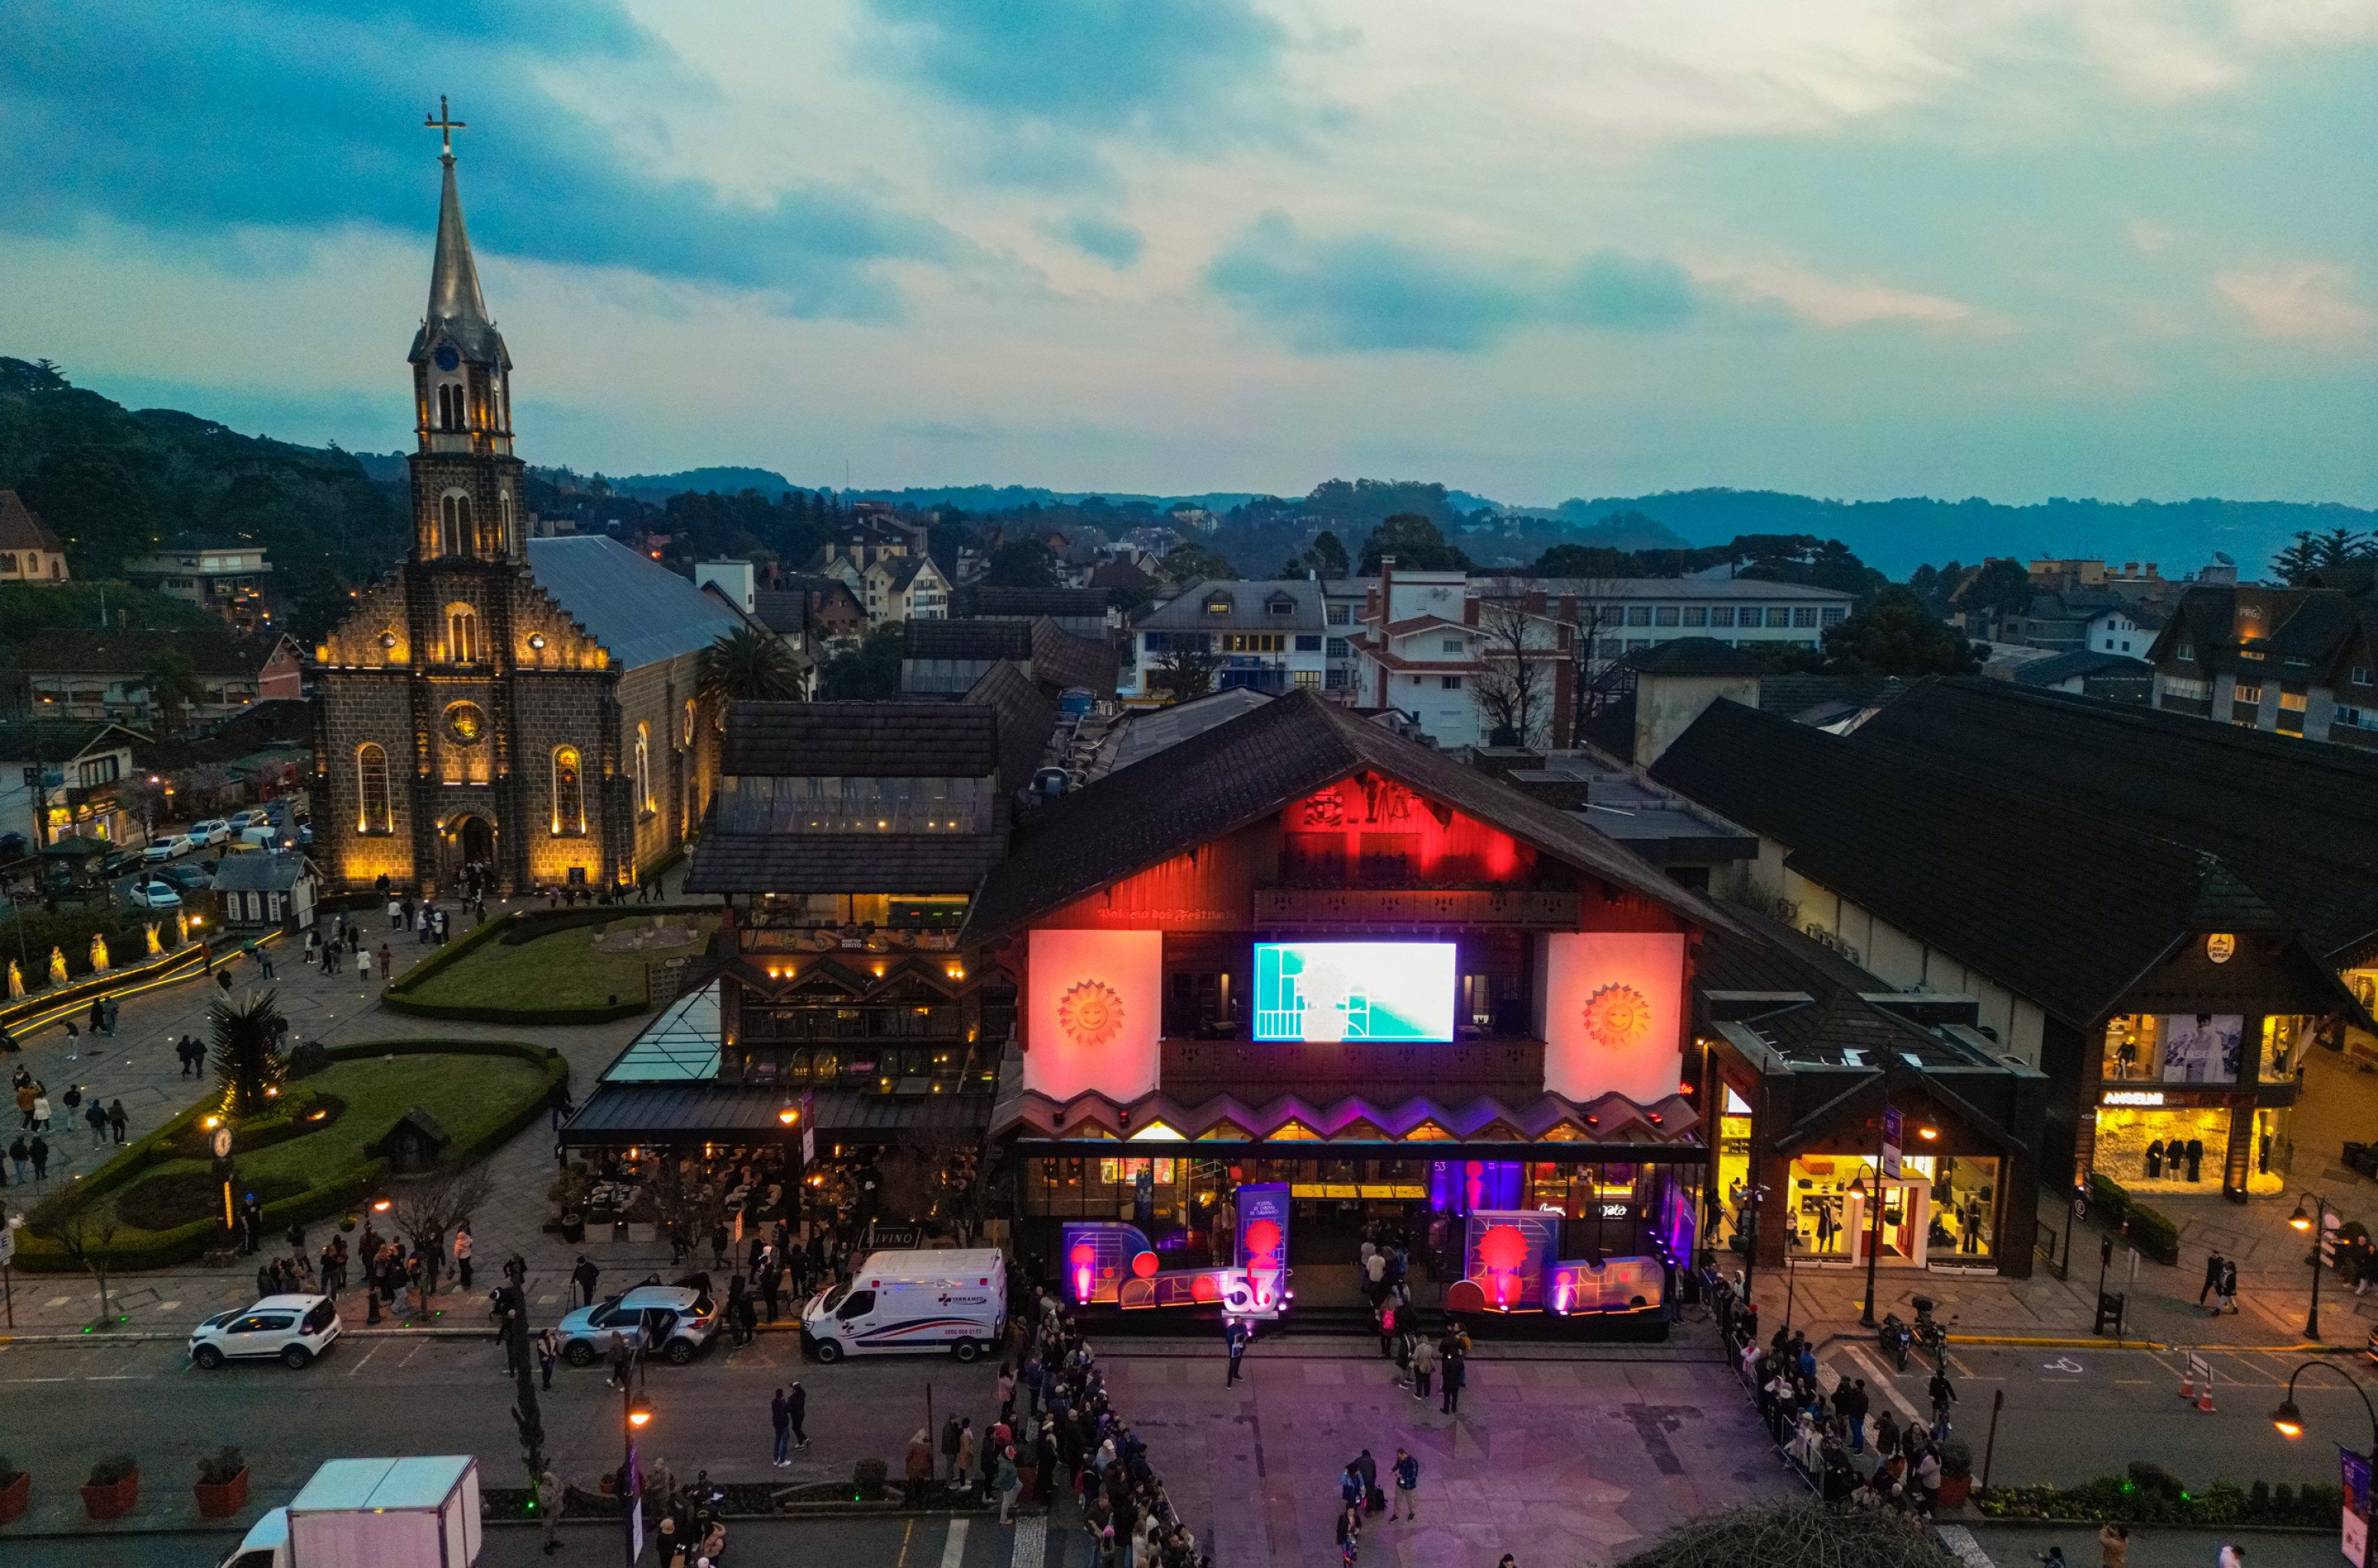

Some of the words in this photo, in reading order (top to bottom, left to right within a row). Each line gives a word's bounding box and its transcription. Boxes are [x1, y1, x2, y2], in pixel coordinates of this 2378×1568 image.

[1152, 908, 1172, 919] dos
[2103, 1092, 2163, 1105] ANSELMI
[1434, 1162, 1446, 1171] 53
[1224, 1268, 1280, 1313] 53
